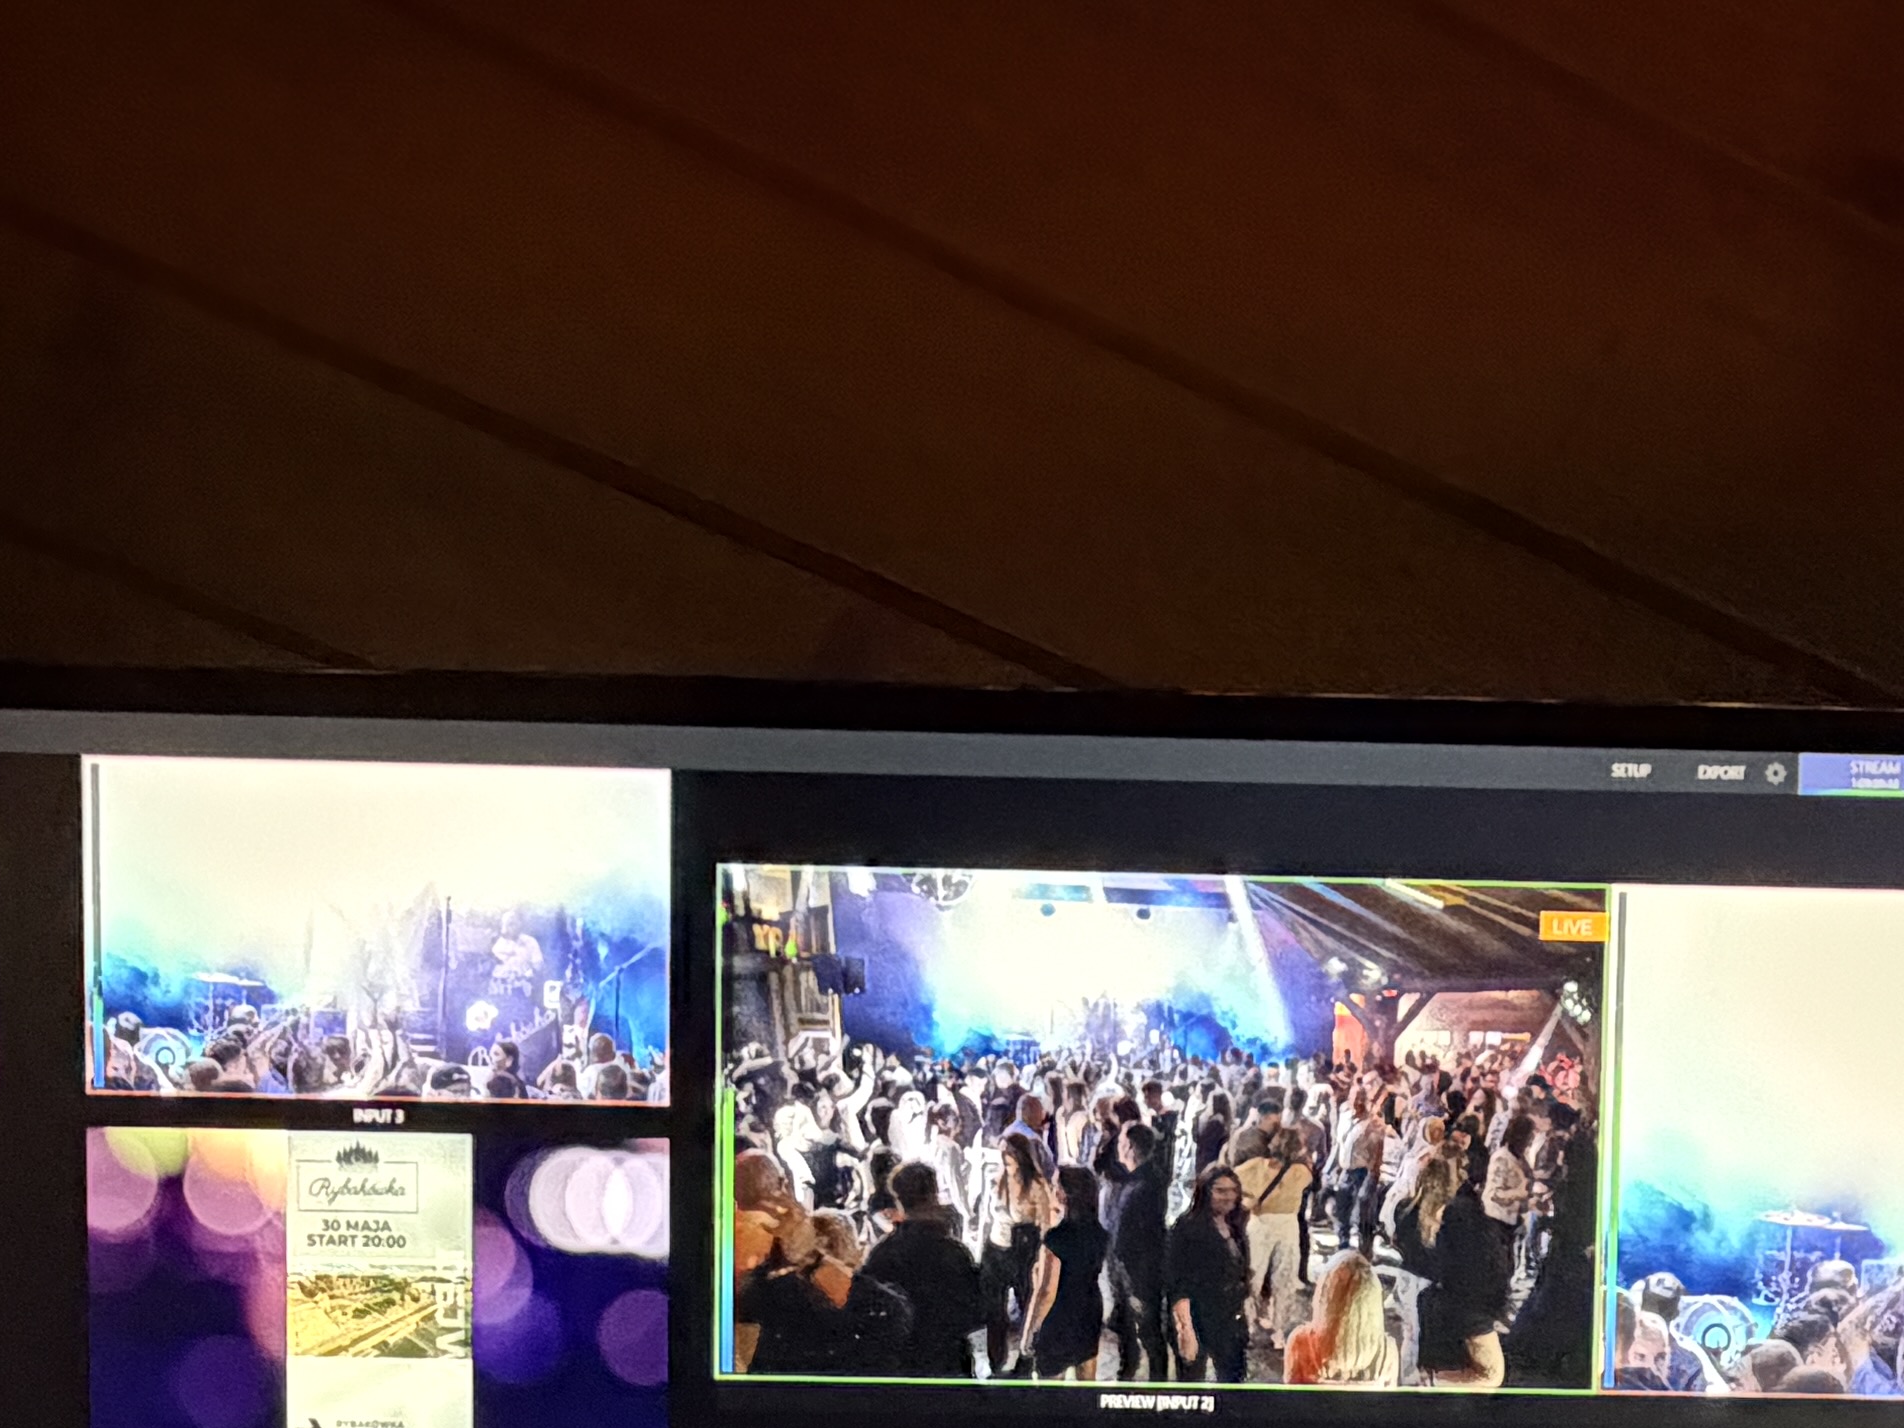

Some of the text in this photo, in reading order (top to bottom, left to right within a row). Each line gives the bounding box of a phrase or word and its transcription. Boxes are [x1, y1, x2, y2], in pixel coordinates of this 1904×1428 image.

[1611, 763, 1652, 778] SETUP
[1697, 764, 1746, 780] EXPORT
[1850, 760, 1902, 774] STREAM
[1552, 917, 1593, 936] LIVE
[353, 1109, 392, 1123] INPUT
[322, 1219, 392, 1232] 30 MAJA
[307, 1234, 407, 1248] START 20:00
[1100, 1394, 1154, 1409] PREVIEW
